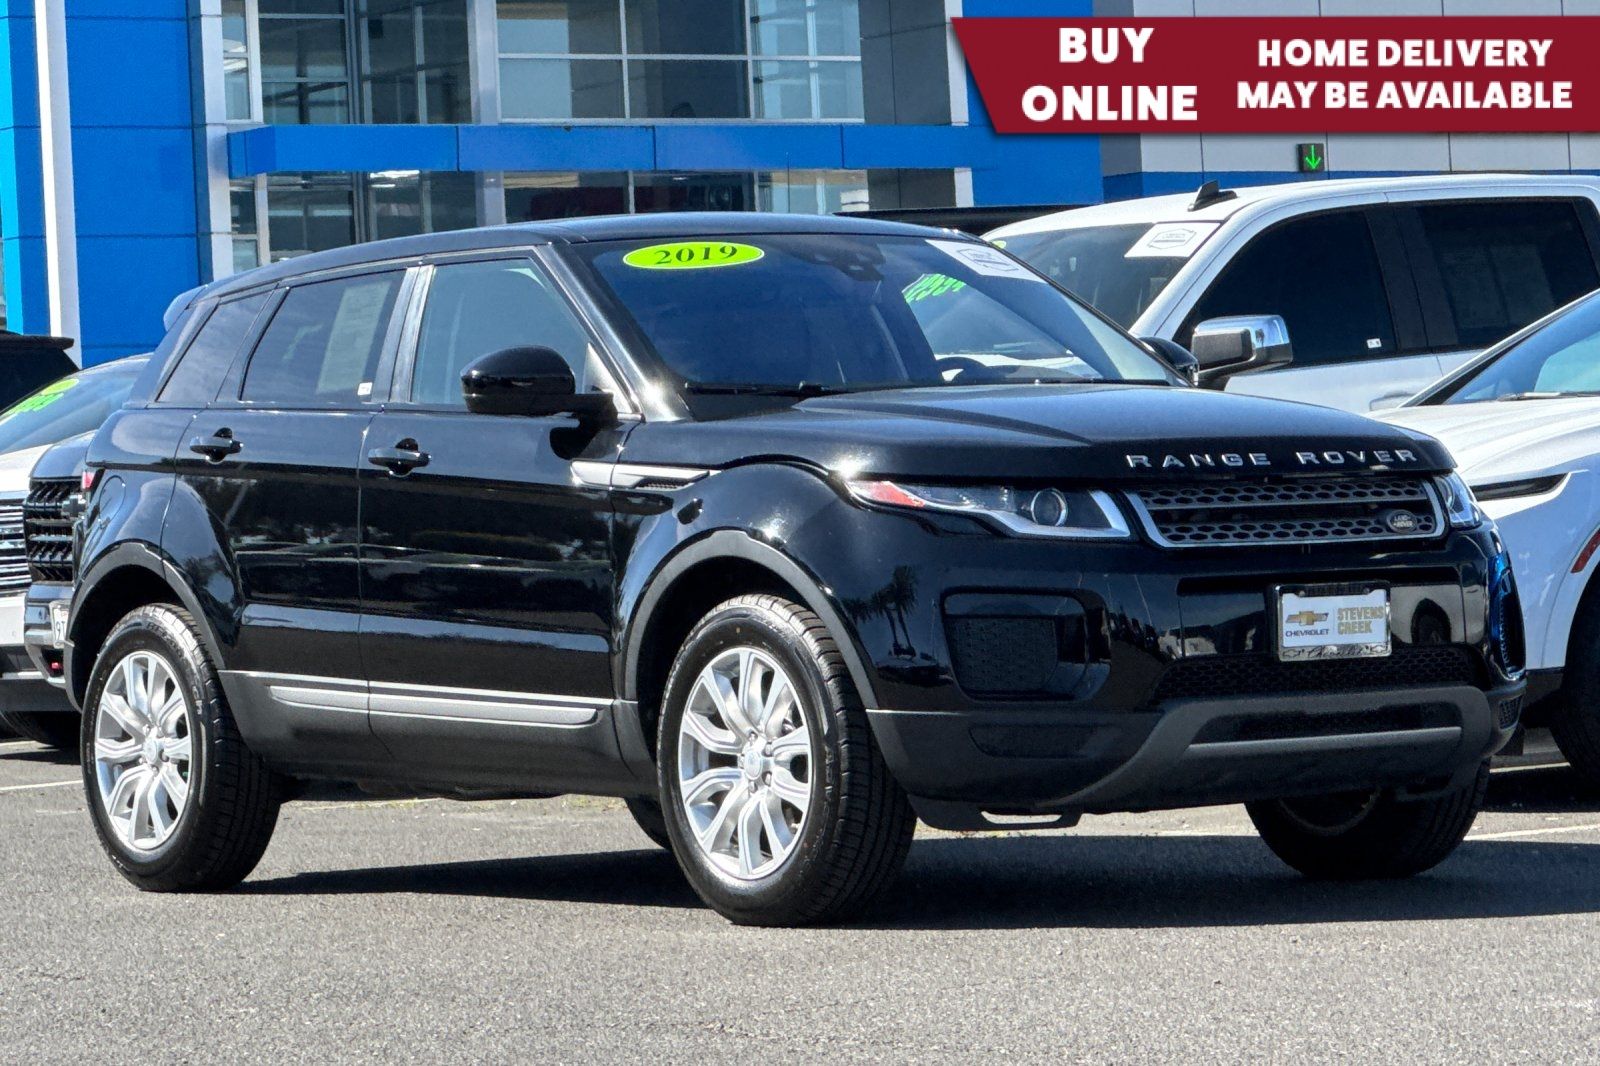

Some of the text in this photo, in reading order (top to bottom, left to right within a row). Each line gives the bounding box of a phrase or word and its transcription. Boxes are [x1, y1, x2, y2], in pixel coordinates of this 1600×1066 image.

[653, 245, 738, 265] 2019
[1126, 449, 1418, 468] RANGE ROVER
[1337, 606, 1384, 620] STEVENS
[1285, 628, 1330, 637] CHEVROLET
[1337, 620, 1373, 635] CREEK
